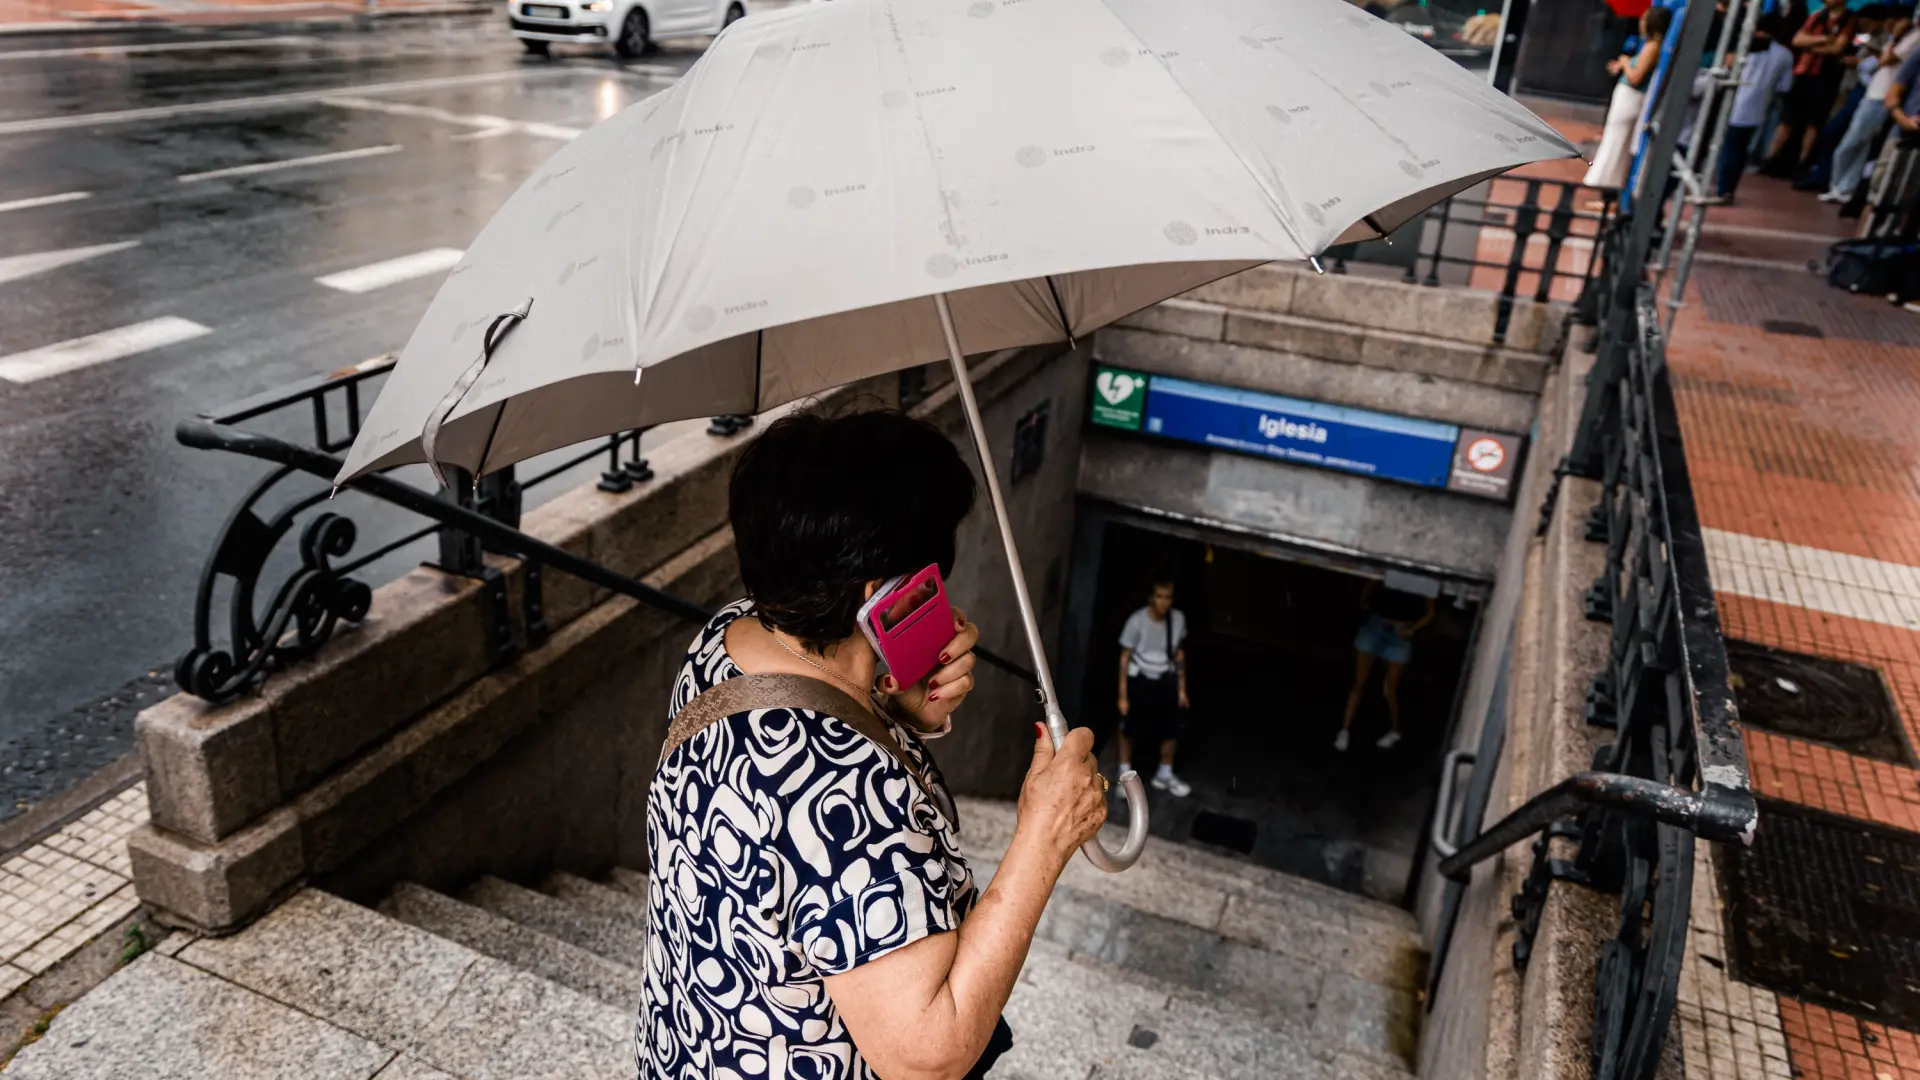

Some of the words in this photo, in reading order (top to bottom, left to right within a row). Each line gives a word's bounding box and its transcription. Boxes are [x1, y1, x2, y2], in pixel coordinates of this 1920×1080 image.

[1052, 145, 1096, 157] Indra
[824, 183, 866, 197] Indra
[1320, 195, 1342, 211] Indra
[1205, 225, 1251, 237] Indra
[965, 252, 1009, 266] Indra
[724, 299, 769, 316] Indra
[1258, 413, 1328, 444] Iglesia
